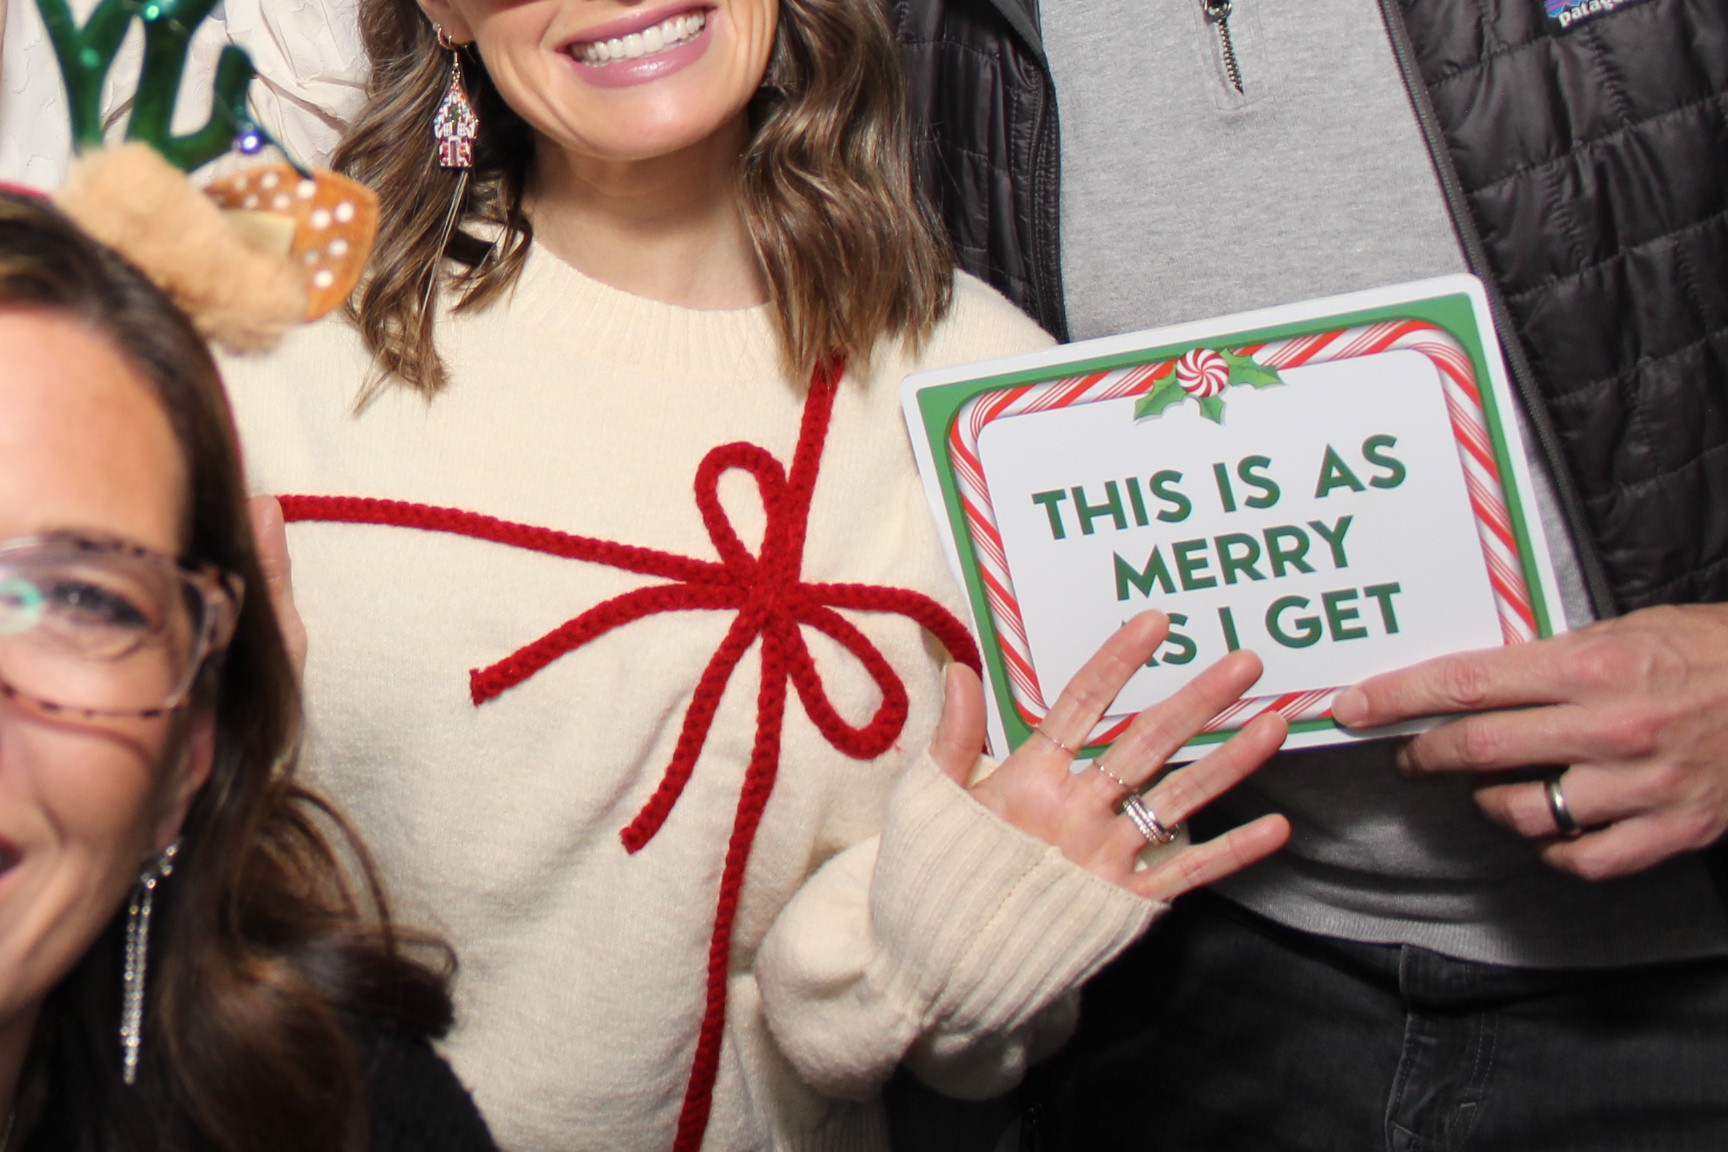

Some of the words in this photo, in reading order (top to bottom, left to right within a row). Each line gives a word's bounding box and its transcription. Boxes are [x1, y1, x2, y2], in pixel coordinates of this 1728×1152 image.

[1031, 469, 1192, 541] THIS
[1212, 454, 1281, 513] IS
[1313, 434, 1407, 500] AS
[1111, 515, 1355, 603] MERRY
[1120, 611, 1198, 667] S
[1217, 606, 1241, 653] I
[1265, 581, 1403, 650] GET
